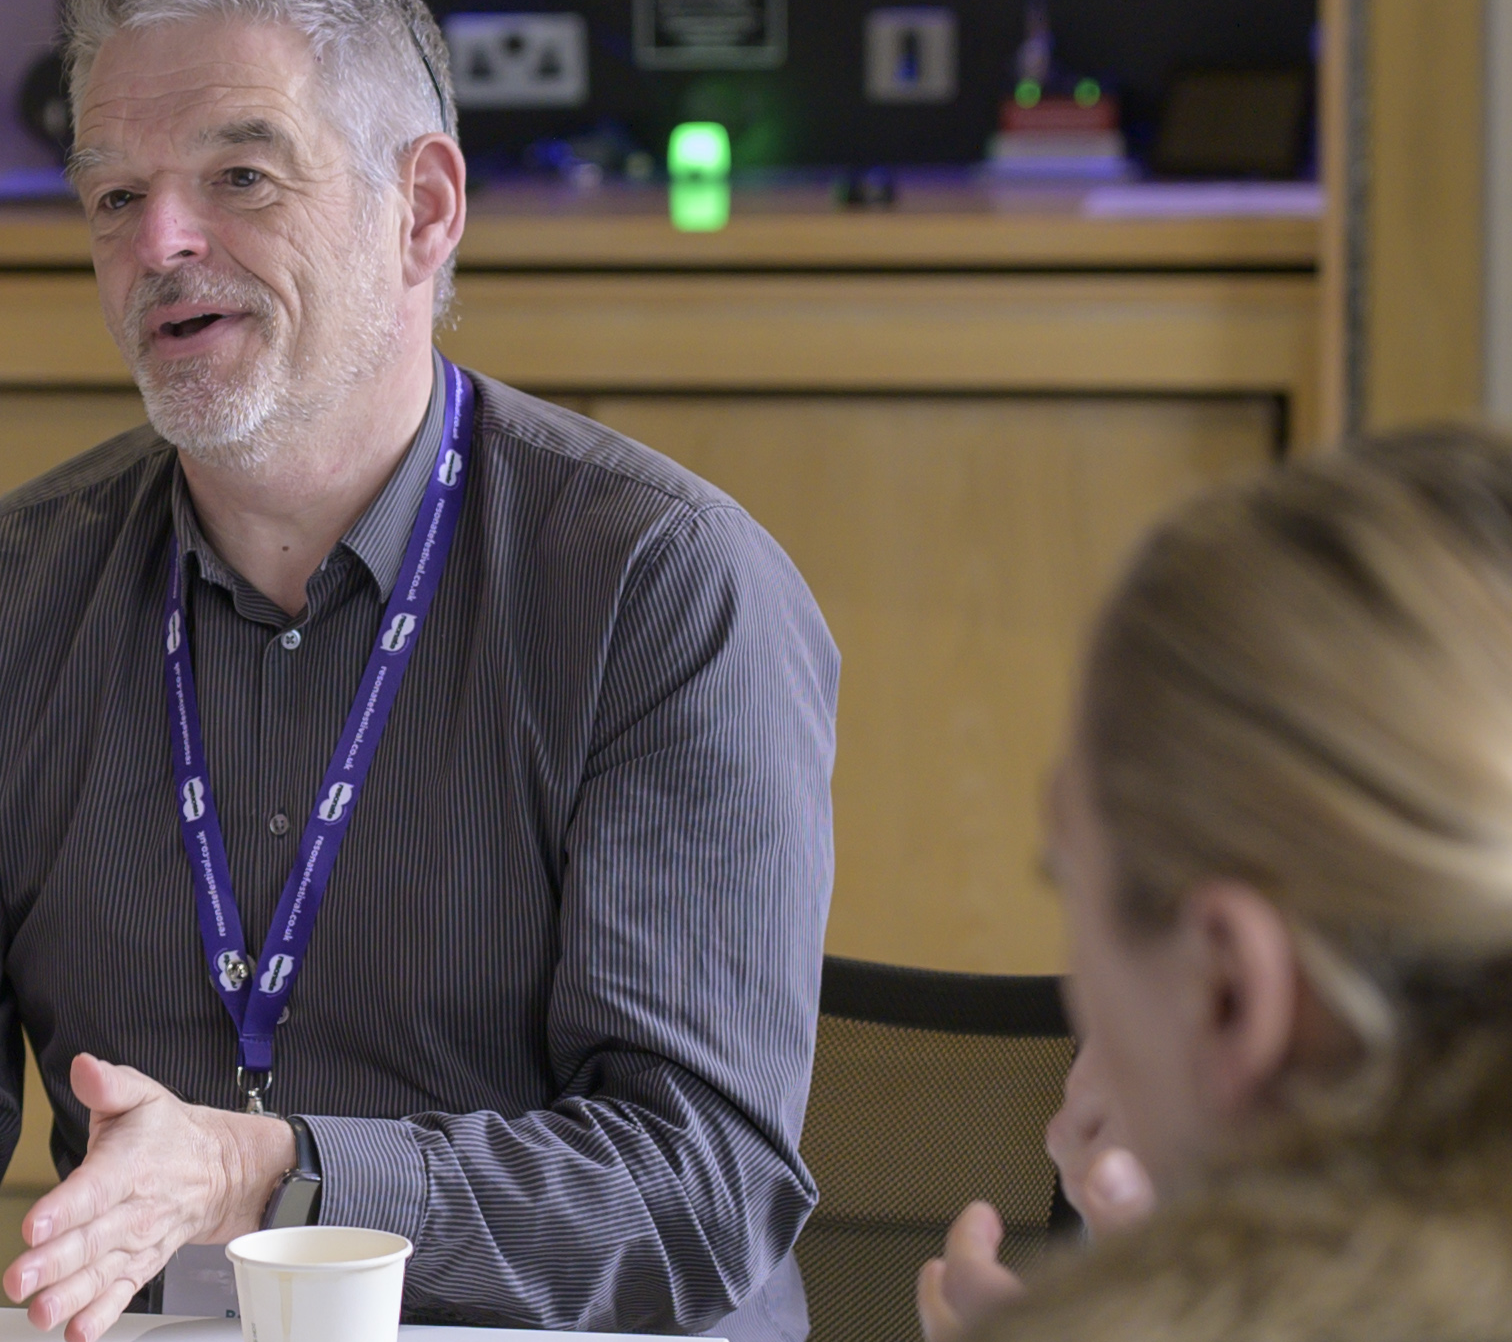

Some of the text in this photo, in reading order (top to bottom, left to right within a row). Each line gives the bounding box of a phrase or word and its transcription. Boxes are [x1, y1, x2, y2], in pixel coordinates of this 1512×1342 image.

[406, 498, 445, 602] resonatefestival.co.uk
[343, 665, 387, 771] resonatefestival.co.uk
[196, 830, 226, 937] resonatefestival.co.uk
[282, 835, 324, 942] resonatefestival.co.uk
